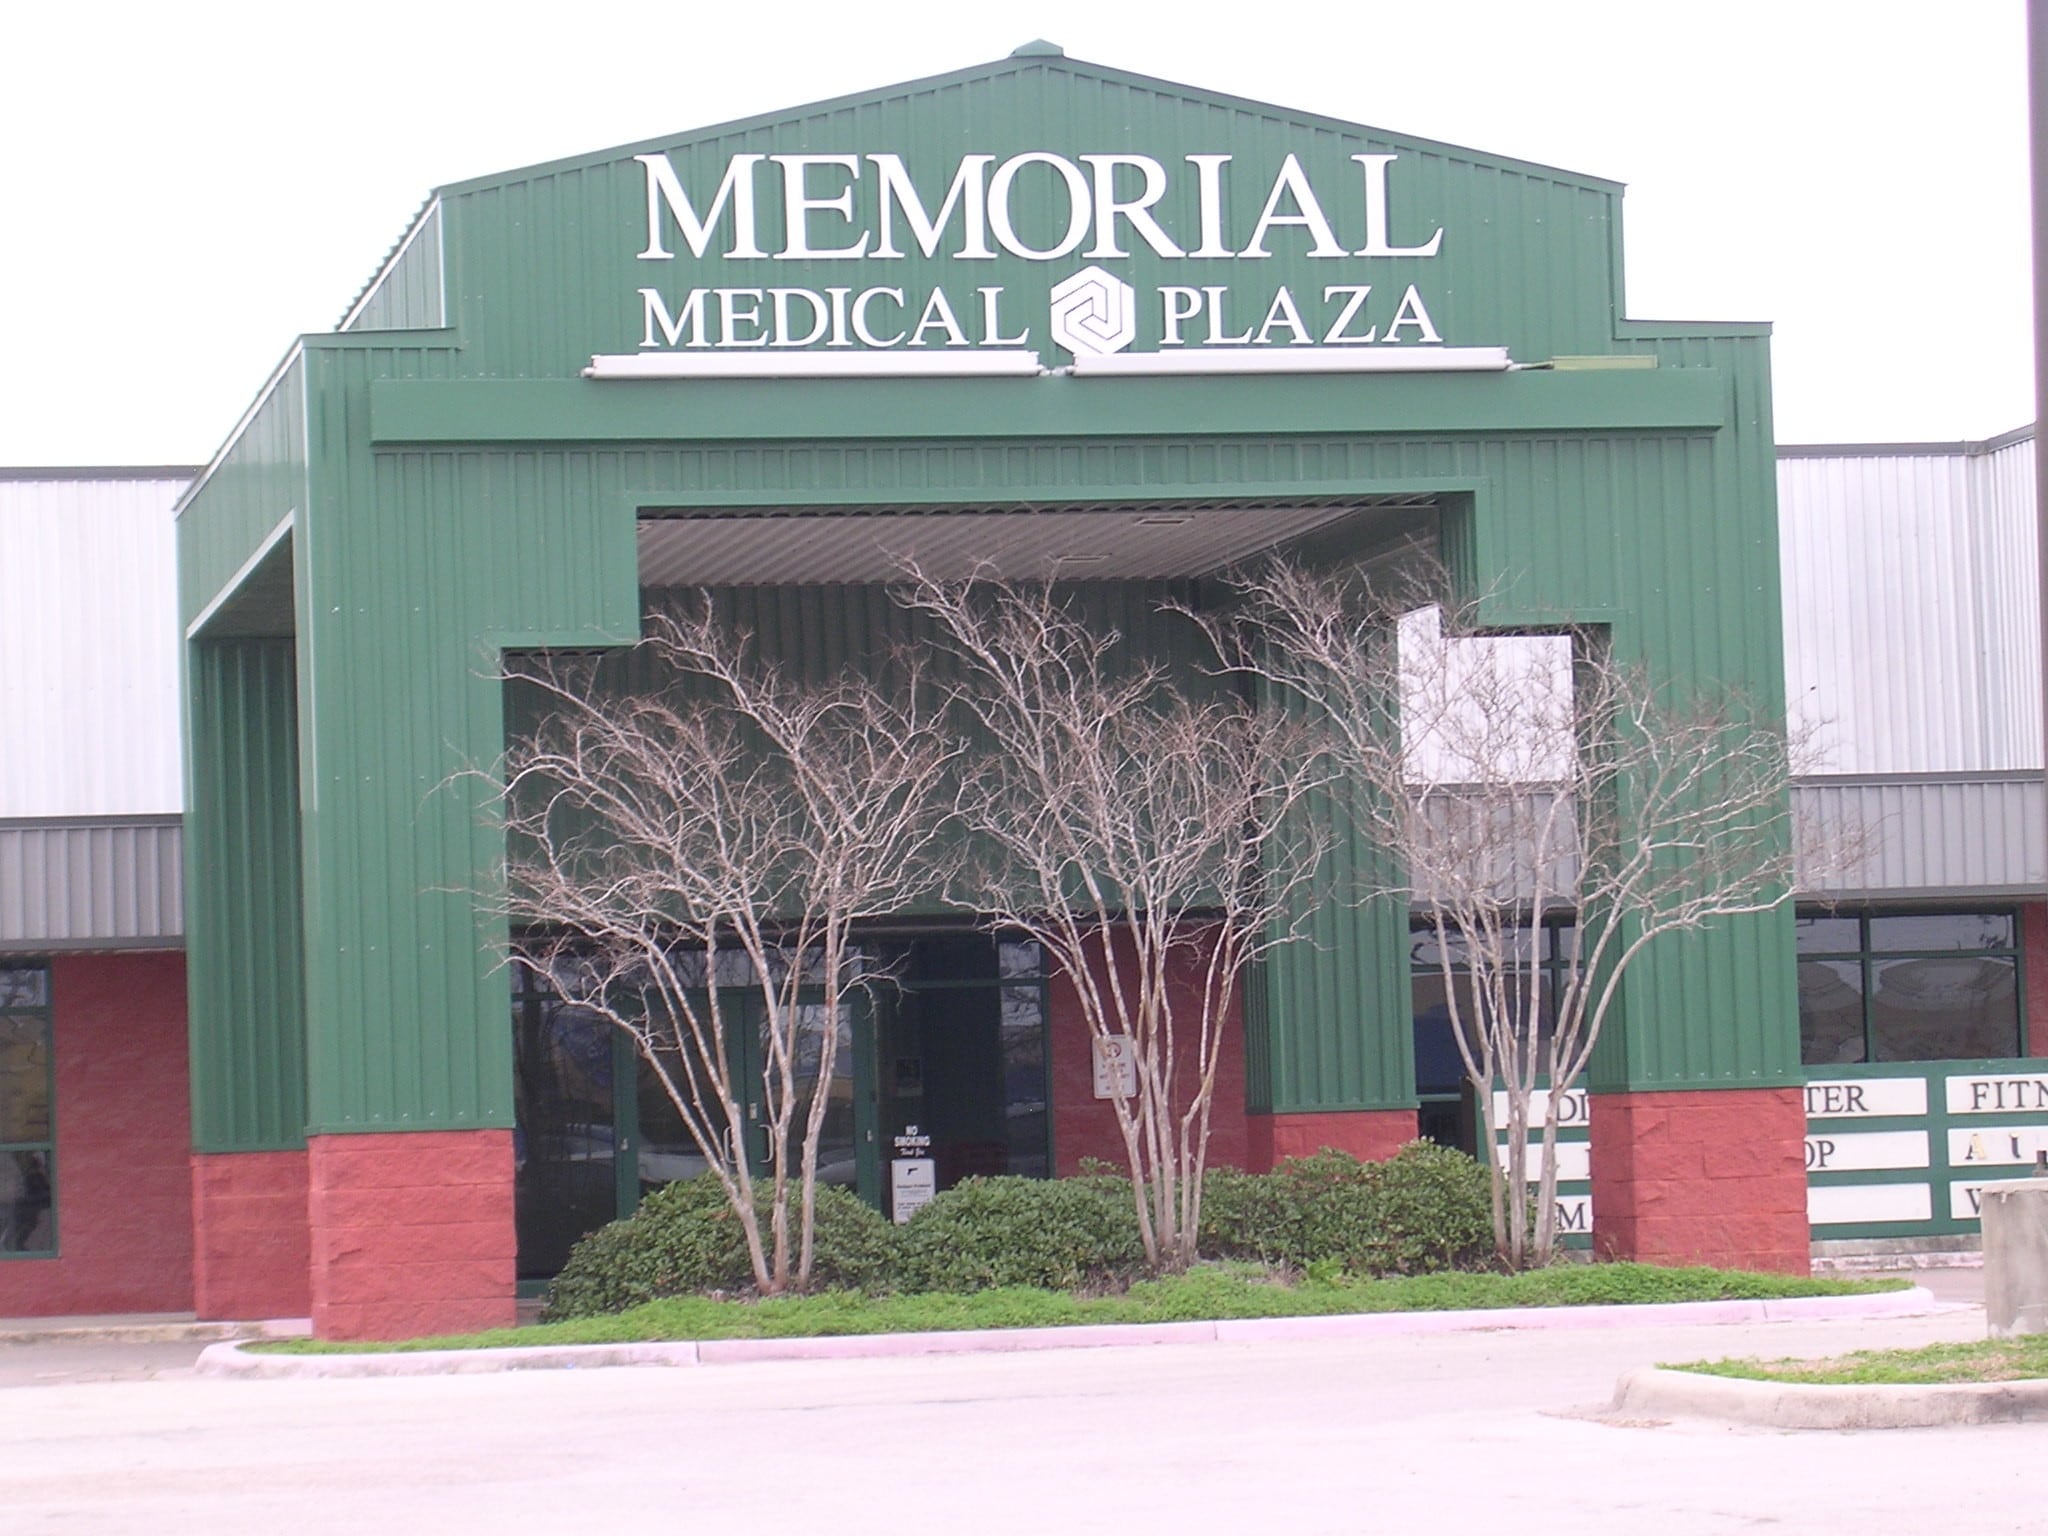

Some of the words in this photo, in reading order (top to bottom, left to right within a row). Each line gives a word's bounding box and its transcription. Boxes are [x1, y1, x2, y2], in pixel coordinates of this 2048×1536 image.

[633, 152, 1443, 260] MEMORIAL
[637, 285, 1030, 348] MEDICAL
[1157, 284, 1443, 345] PLAZA
